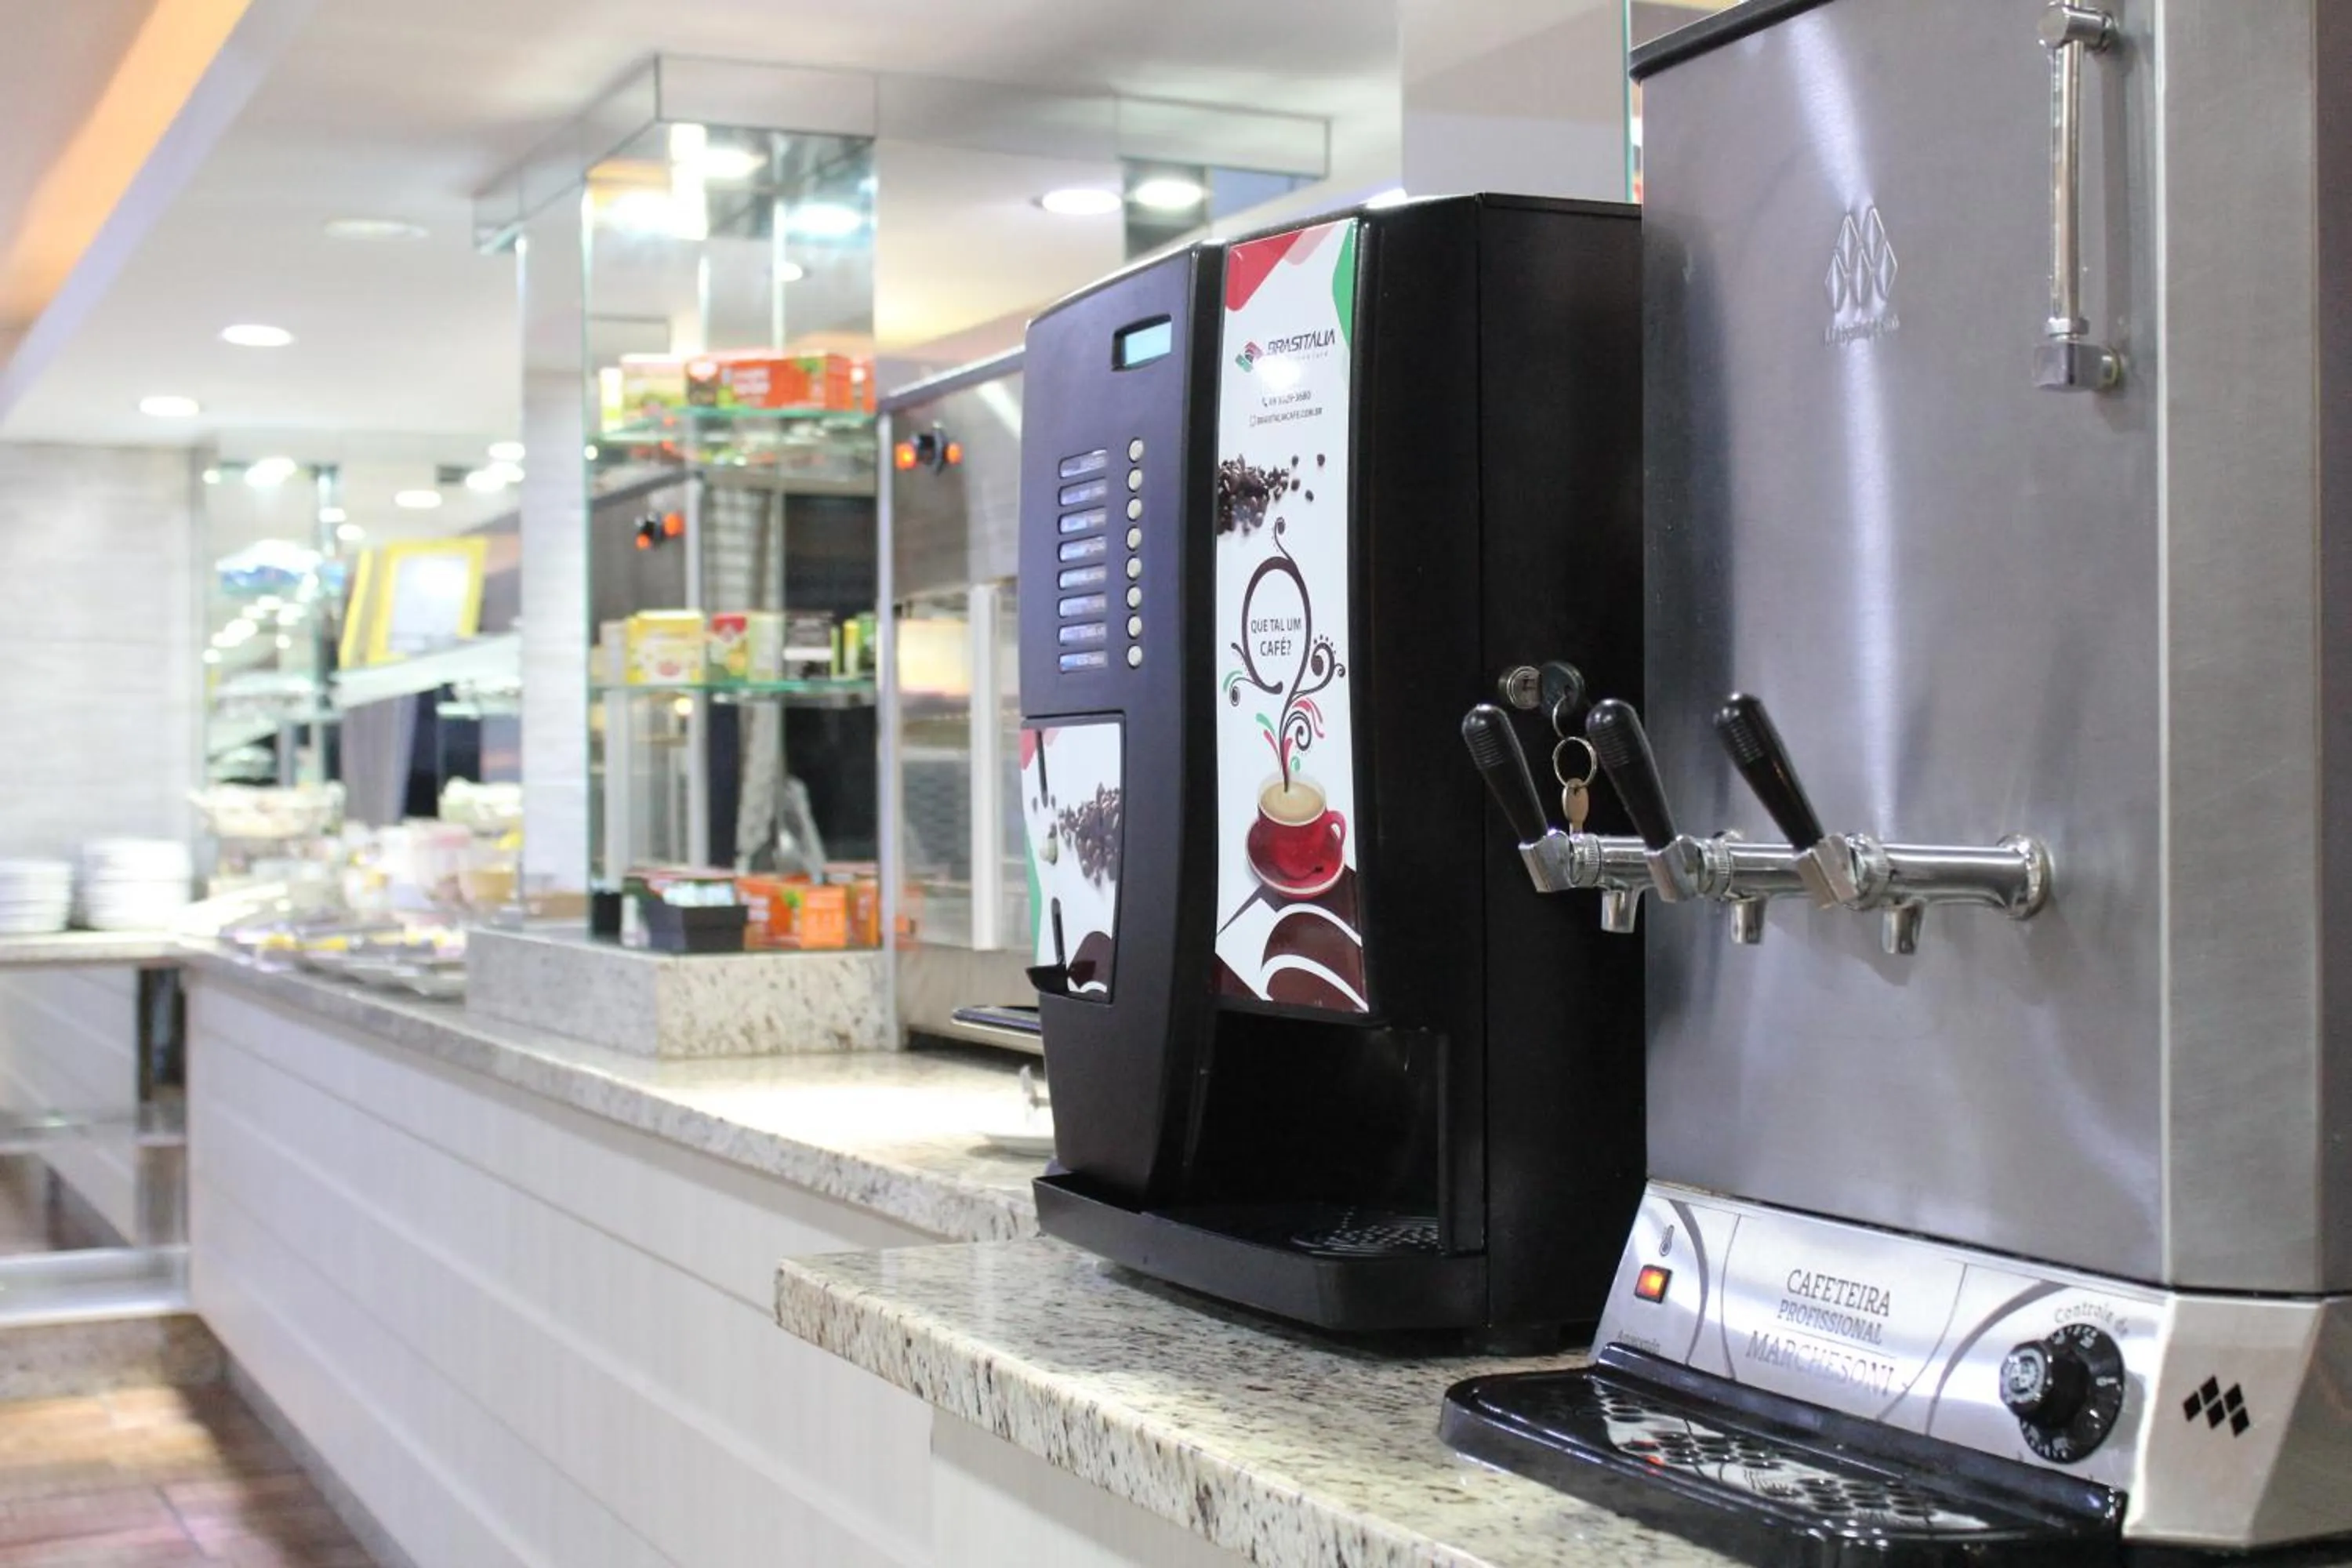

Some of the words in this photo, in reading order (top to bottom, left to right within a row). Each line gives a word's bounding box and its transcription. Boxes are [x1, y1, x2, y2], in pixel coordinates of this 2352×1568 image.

[1250, 619, 1268, 633] QUE
[1270, 618, 1284, 631] TAL
[1287, 617, 1302, 631] UM
[1260, 636, 1291, 656] CAFÉ?
[1787, 1269, 1890, 1317] CAFETEIRA
[1777, 1299, 1882, 1345] PROFISSIONAL
[1745, 1330, 1894, 1397] MARCHESONI
